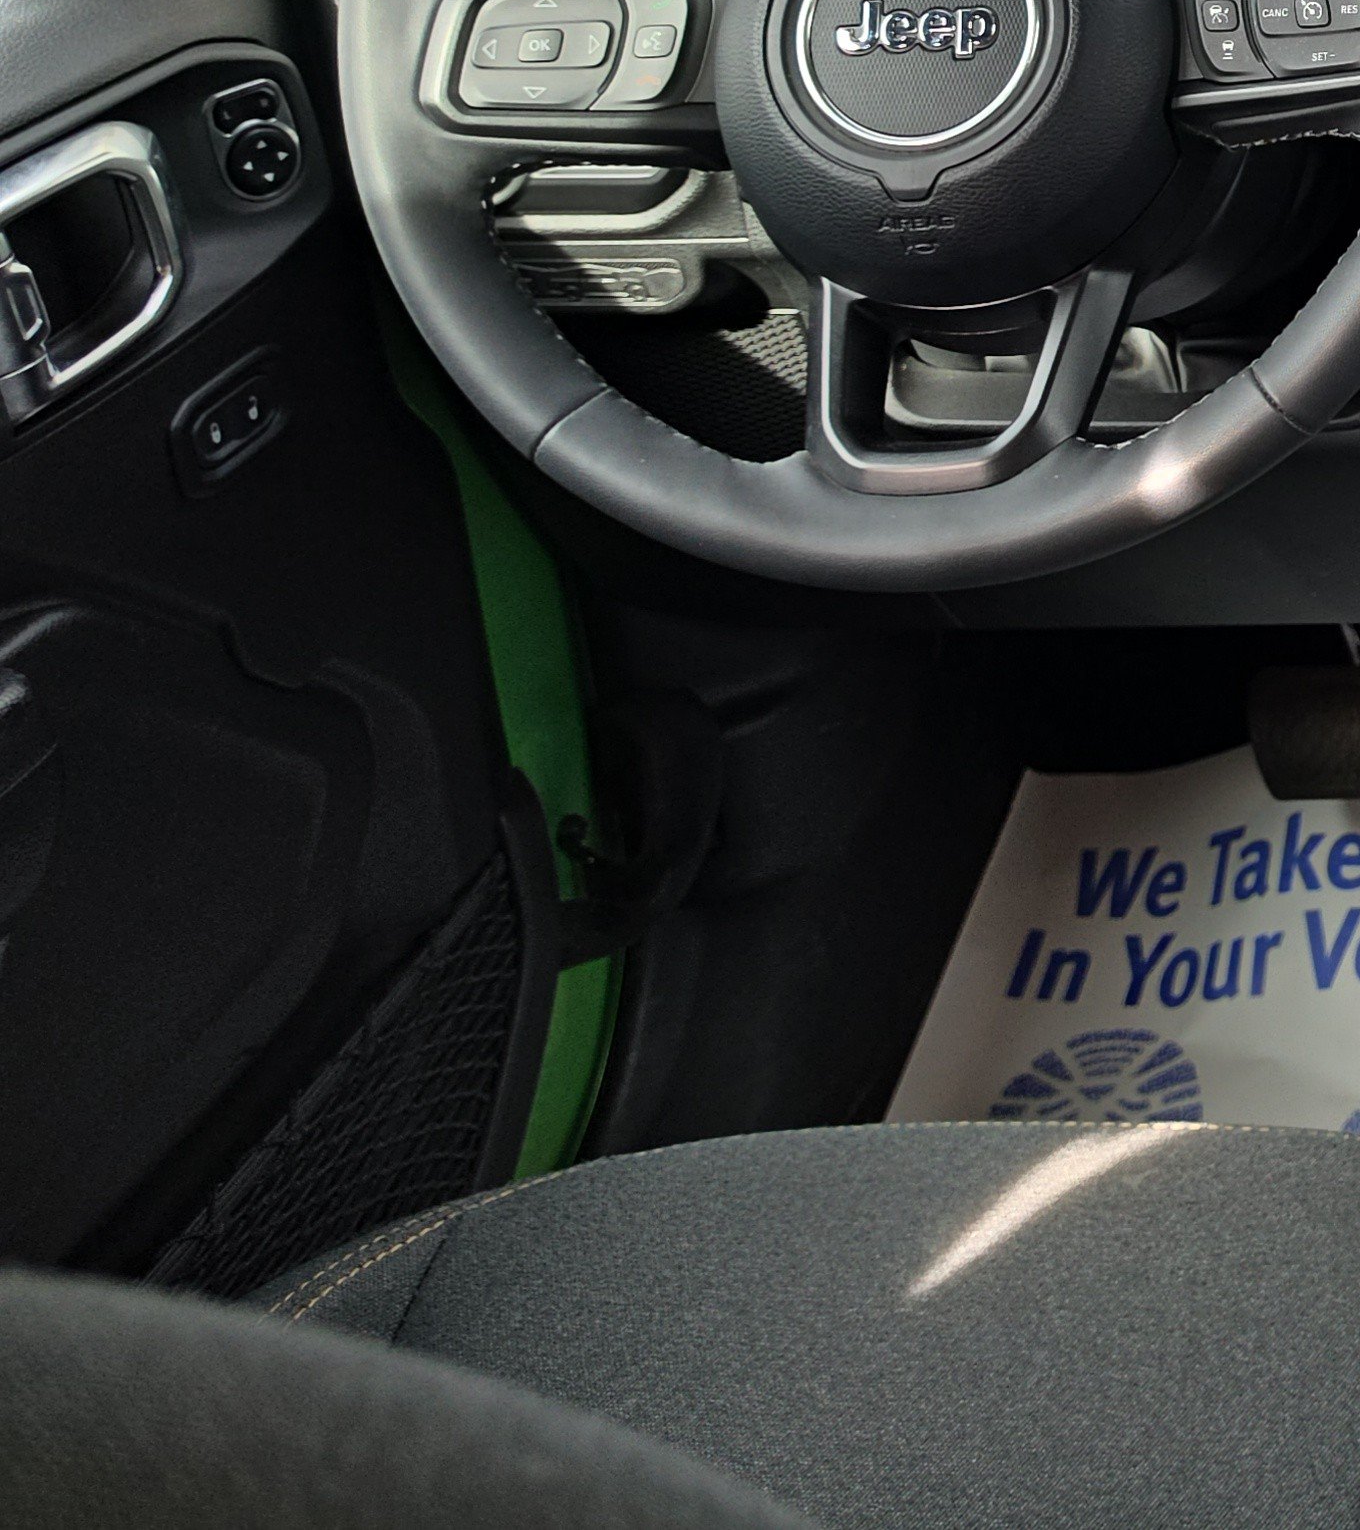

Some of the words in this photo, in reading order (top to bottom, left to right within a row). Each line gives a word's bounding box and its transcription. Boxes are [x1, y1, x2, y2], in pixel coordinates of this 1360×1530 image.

[1262, 7, 1289, 18] CANC
[1340, 4, 1359, 14] RES
[528, 40, 551, 52] OK
[1075, 845, 1187, 920] We
[1006, 928, 1092, 1004] In
[1123, 926, 1283, 1008] Your
